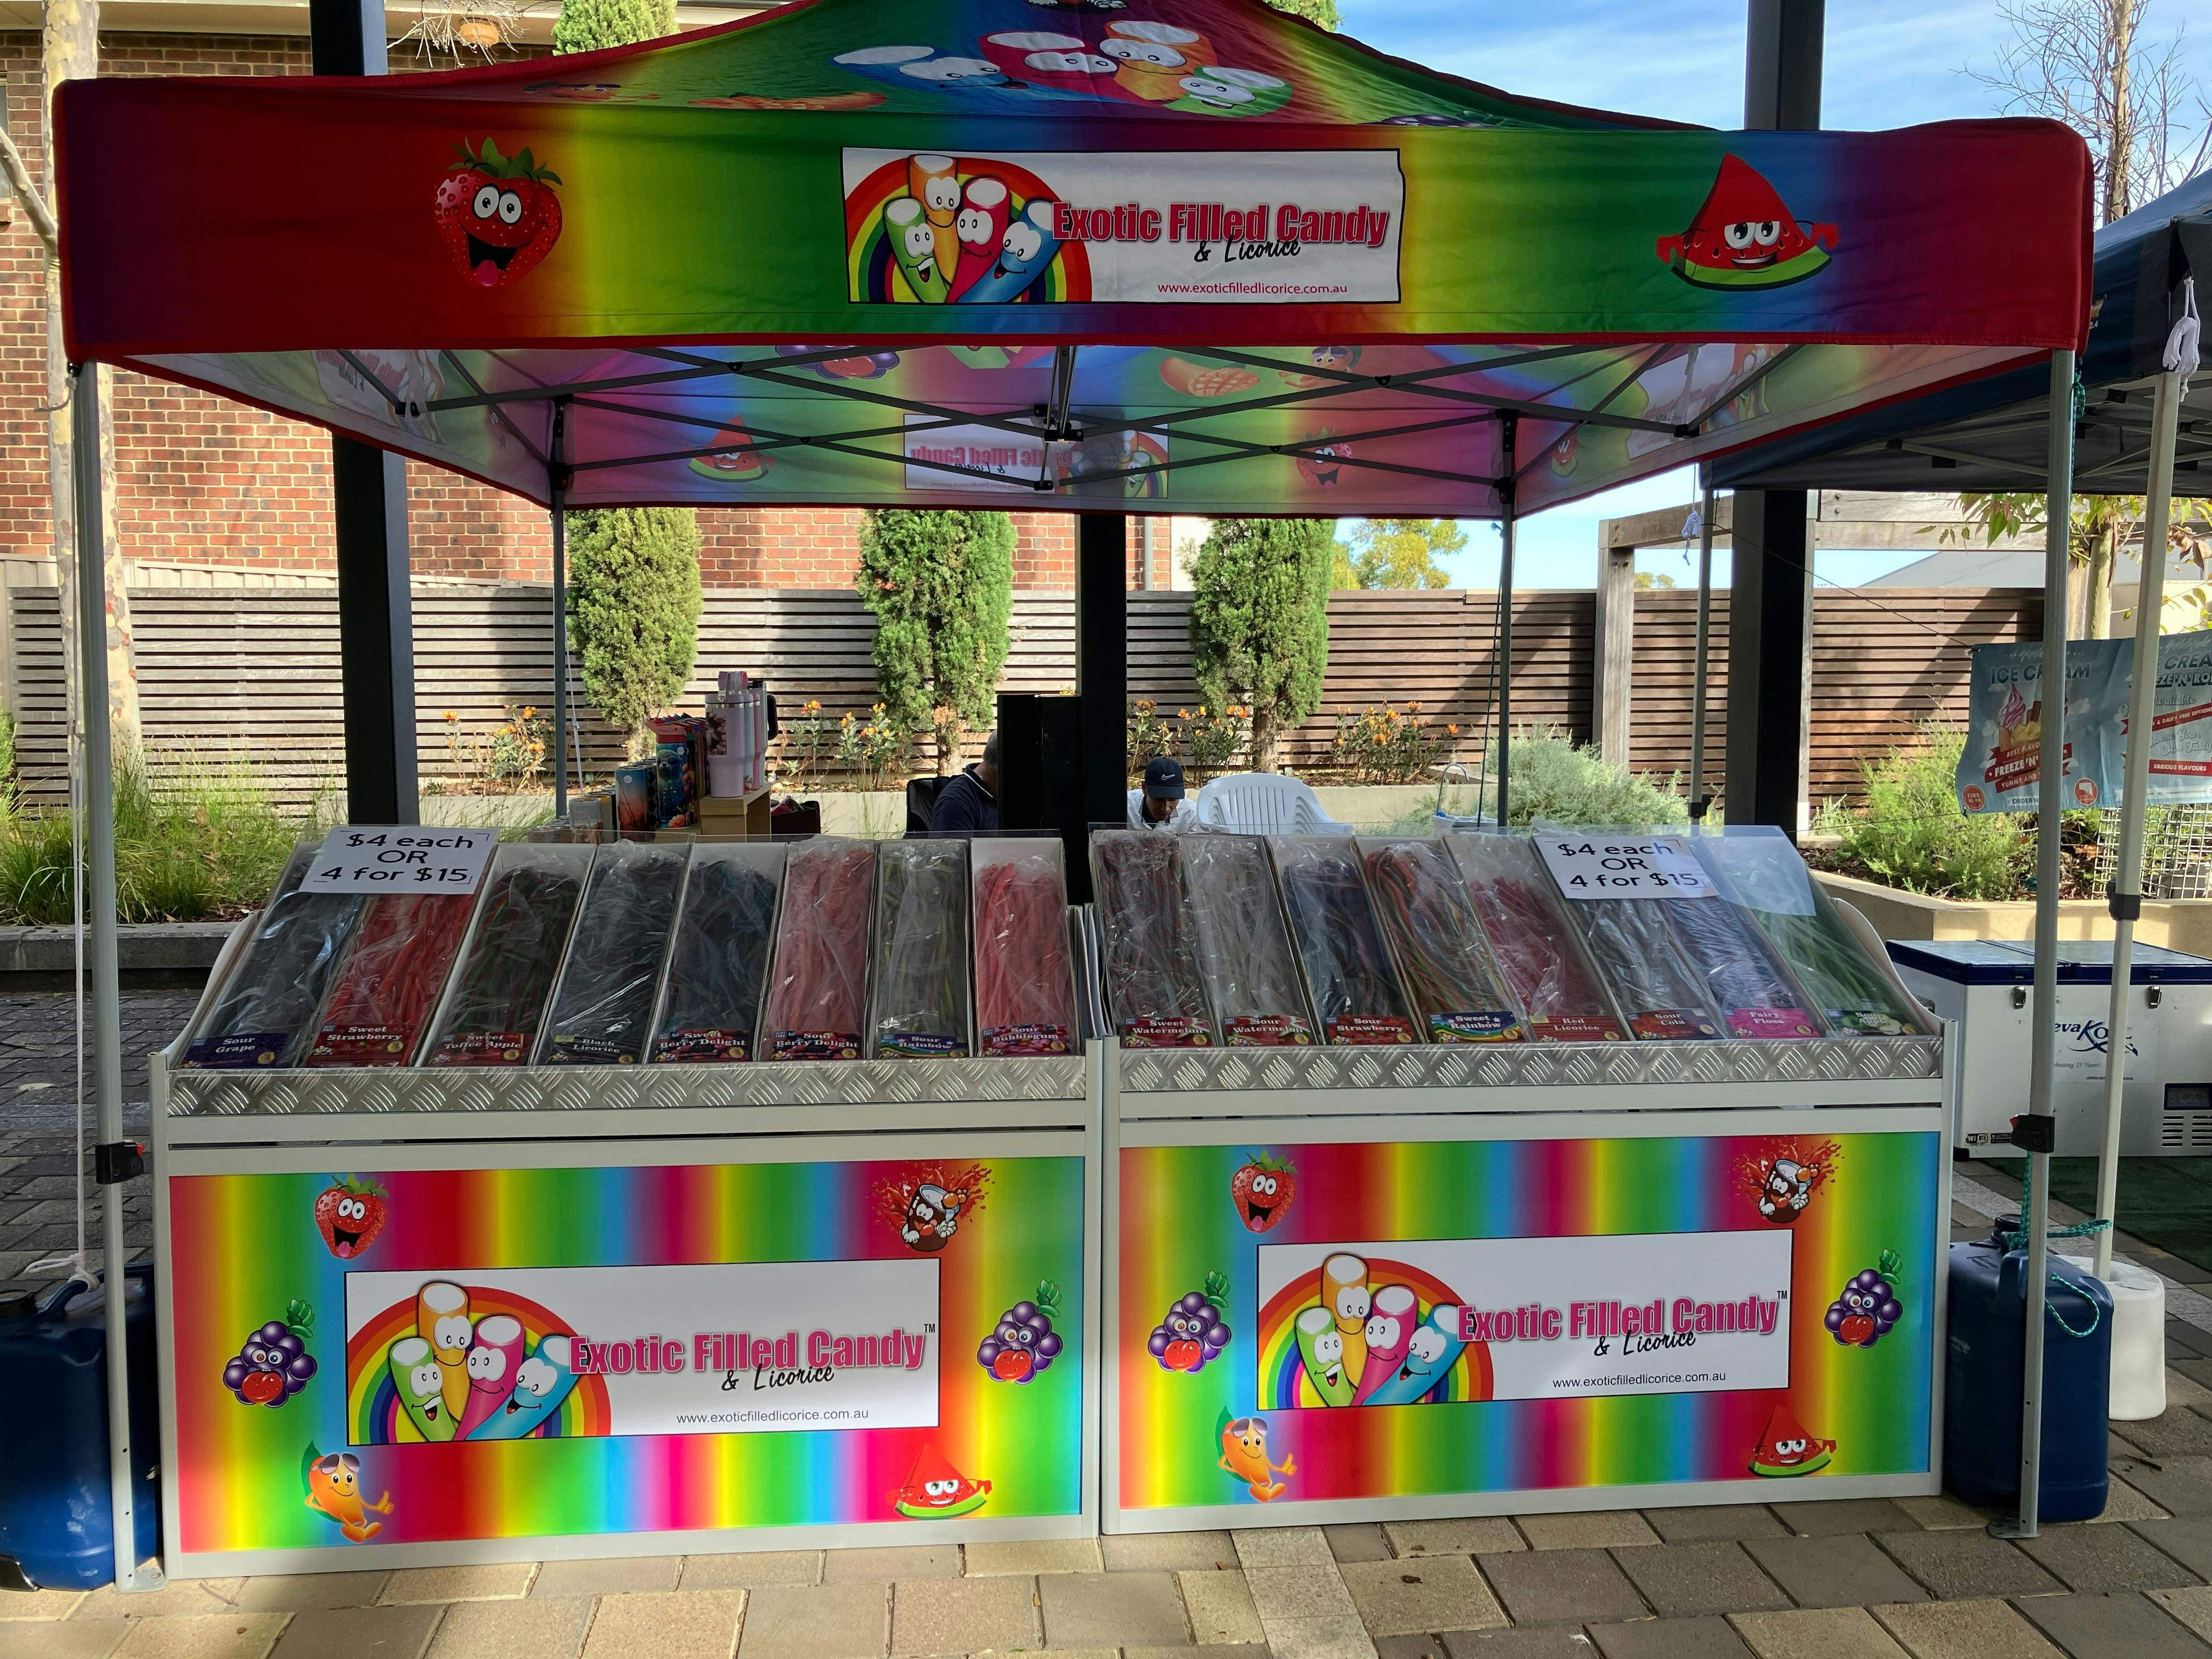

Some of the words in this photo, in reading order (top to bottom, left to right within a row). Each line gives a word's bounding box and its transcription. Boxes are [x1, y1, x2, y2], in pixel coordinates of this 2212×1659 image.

[1052, 201, 1161, 241] Exotic
[1169, 203, 1268, 242] Filled
[1274, 204, 1387, 247] Candy
[1194, 242, 1210, 263] &
[1223, 234, 1300, 263] Licorice
[1158, 281, 1347, 295] www.exoticfilledlicorice.com.au
[2164, 651, 2212, 670] CREA
[1991, 664, 2019, 684] ICE
[2151, 733, 2175, 747] hoose
[2177, 729, 2201, 741] Your
[2006, 748, 2019, 758] BEST
[2022, 741, 2040, 753] FLAVO
[1994, 759, 2024, 777] FREEZE
[2001, 777, 2022, 788] YUMMY
[2024, 772, 2037, 782] AND
[346, 833, 387, 847] $4
[397, 836, 473, 849] each
[377, 850, 428, 864] OR
[1558, 843, 1595, 856] $4
[1605, 843, 1673, 855] each
[1601, 858, 1649, 870] OR
[320, 867, 342, 879] 4
[353, 867, 404, 881] for
[413, 867, 468, 882] $15
[1570, 875, 1588, 887] 4
[1595, 874, 1640, 887] for
[1649, 872, 1698, 887] $15
[814, 1040, 859, 1048] Delight
[992, 1033, 1059, 1042] Bubblegum
[573, 1045, 620, 1053] Licorice
[1457, 1304, 1561, 1343] Exotic
[1568, 1300, 1663, 1338] Filled
[1671, 1295, 1778, 1334] Candy
[569, 1335, 684, 1374] Exotic
[693, 1331, 797, 1371] Filled
[806, 1328, 924, 1370] Candy
[1594, 1336, 1610, 1356] &
[1623, 1330, 1696, 1356] Licorice
[721, 1370, 739, 1391] &
[753, 1363, 834, 1391] Licorice
[1553, 1372, 1726, 1389] www.exoticfilledlicorice.com.au
[676, 1409, 868, 1424] www.exoticfilledlicorice.com.au
